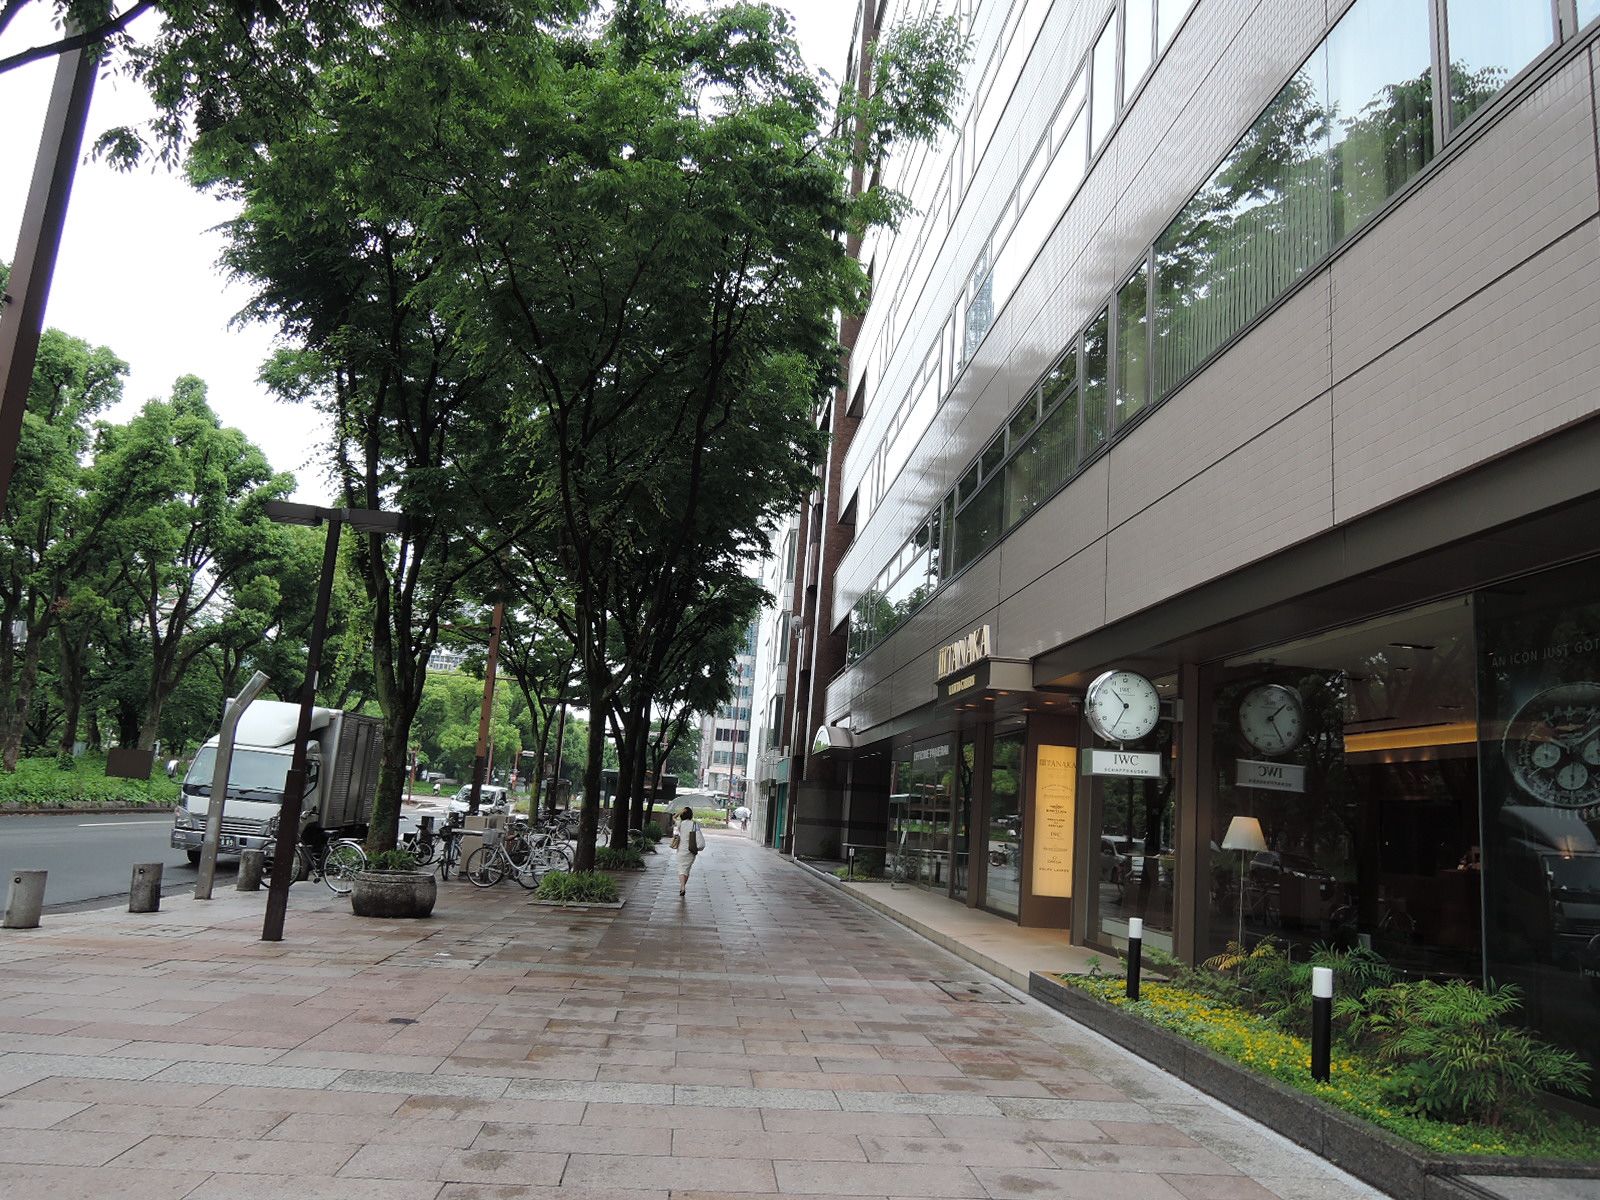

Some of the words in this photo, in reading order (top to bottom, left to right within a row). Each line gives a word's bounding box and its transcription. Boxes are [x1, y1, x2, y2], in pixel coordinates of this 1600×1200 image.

[947, 624, 990, 672] TANAKA
[1492, 656, 1507, 668] AN
[1510, 650, 1537, 665] ICON
[1542, 643, 1568, 659] JUST
[1574, 638, 1600, 654] GOT
[1113, 753, 1139, 766] IWC
